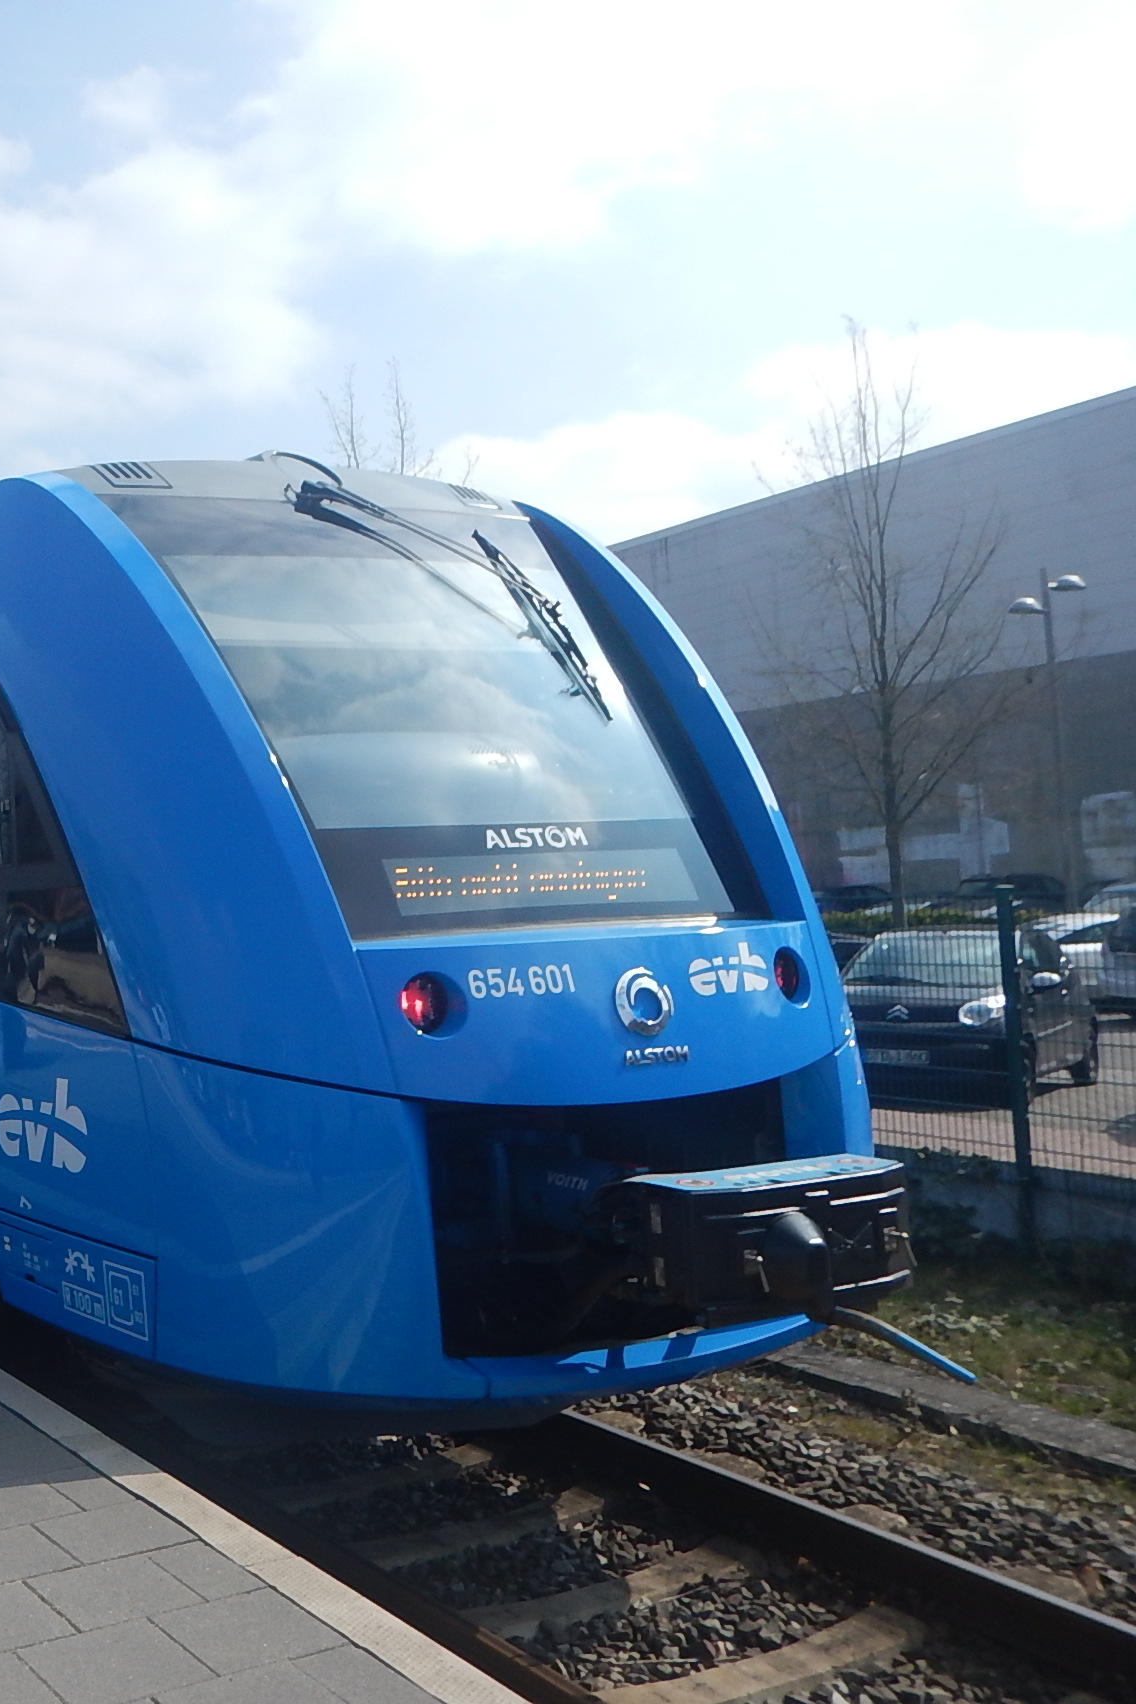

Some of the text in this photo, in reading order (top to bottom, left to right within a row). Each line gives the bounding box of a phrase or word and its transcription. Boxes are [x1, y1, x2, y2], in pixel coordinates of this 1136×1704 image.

[486, 826, 589, 849] ALSTOM
[468, 964, 576, 998] 654 601
[625, 1045, 689, 1066] ALSTOM
[547, 1171, 589, 1191] VOITH
[64, 1286, 72, 1307] R
[73, 1289, 92, 1314] 100
